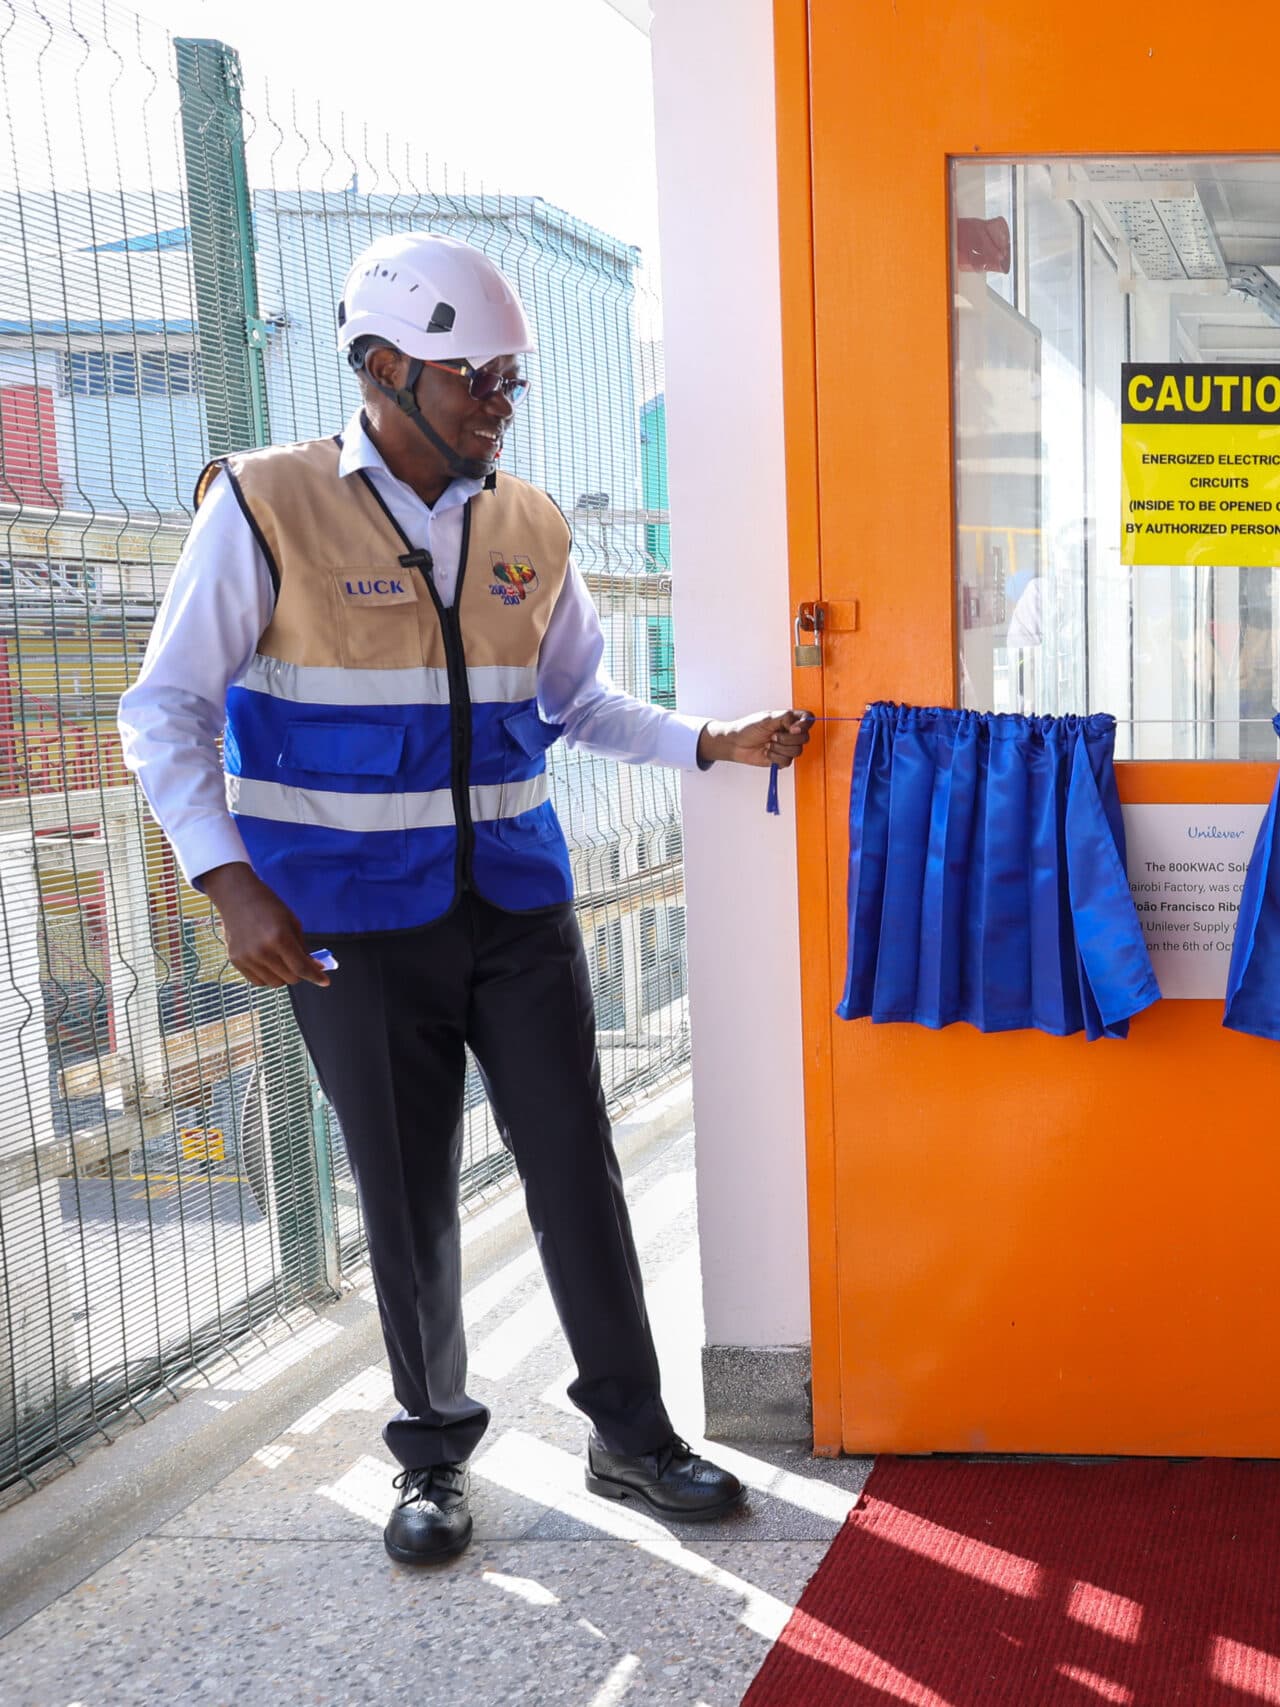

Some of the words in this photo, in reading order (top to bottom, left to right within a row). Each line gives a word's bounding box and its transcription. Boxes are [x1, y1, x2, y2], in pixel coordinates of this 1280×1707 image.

[1142, 454, 1215, 465] ENERGIZED
[1190, 477, 1249, 489] CIRCUITS
[1129, 500, 1175, 512] (INSIDE
[1178, 500, 1195, 512] TO
[1199, 501, 1216, 512] BE
[1219, 501, 1273, 512] OPENED
[1125, 523, 1143, 534] BY
[1145, 523, 1227, 535] AUTHORIZED
[345, 579, 404, 595] LUCK
[1187, 826, 1245, 839] Unilever
[1144, 862, 1166, 872] The
[1168, 862, 1225, 873] 800KWAC
[1164, 882, 1206, 894] Factory,
[1209, 884, 1230, 892] was
[1160, 901, 1215, 912] Francisco
[1147, 921, 1190, 932] Unilever
[1193, 921, 1230, 934] Supply
[1147, 943, 1162, 952] on
[1163, 941, 1180, 952] the
[1182, 941, 1200, 952] 6th
[1203, 941, 1213, 952] of
